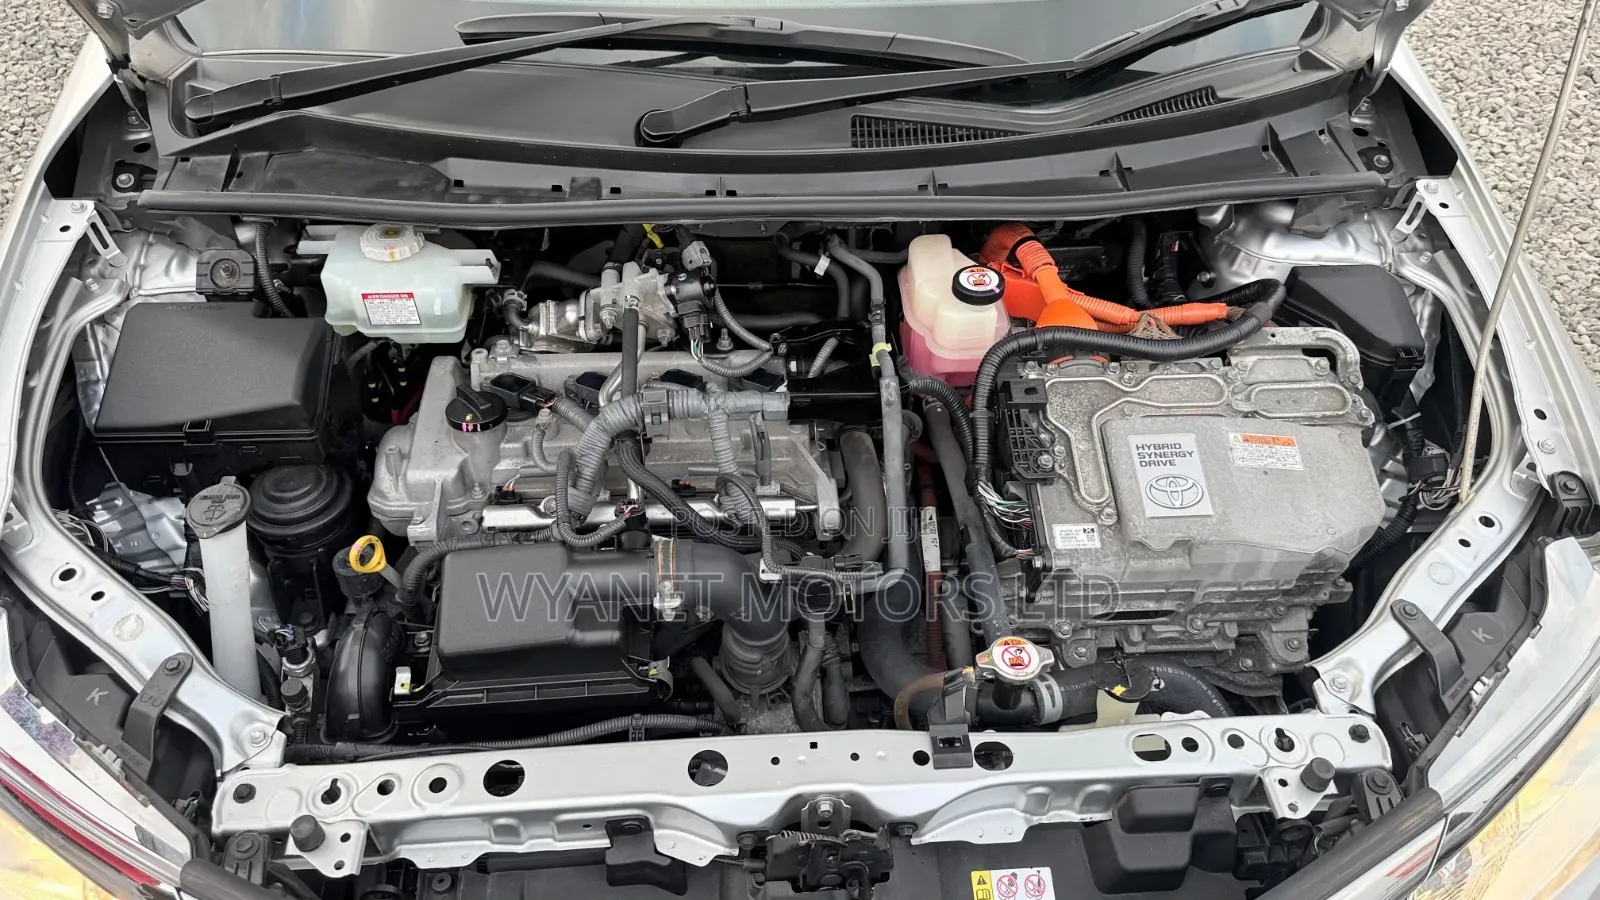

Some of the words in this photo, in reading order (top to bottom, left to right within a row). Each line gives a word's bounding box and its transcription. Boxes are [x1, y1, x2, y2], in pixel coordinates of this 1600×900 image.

[1136, 443, 1182, 451] HYBRID
[1137, 450, 1194, 459] SYNERGY
[1139, 459, 1177, 467] DRIVE
[1472, 627, 1494, 643] K
[85, 687, 109, 706] K
